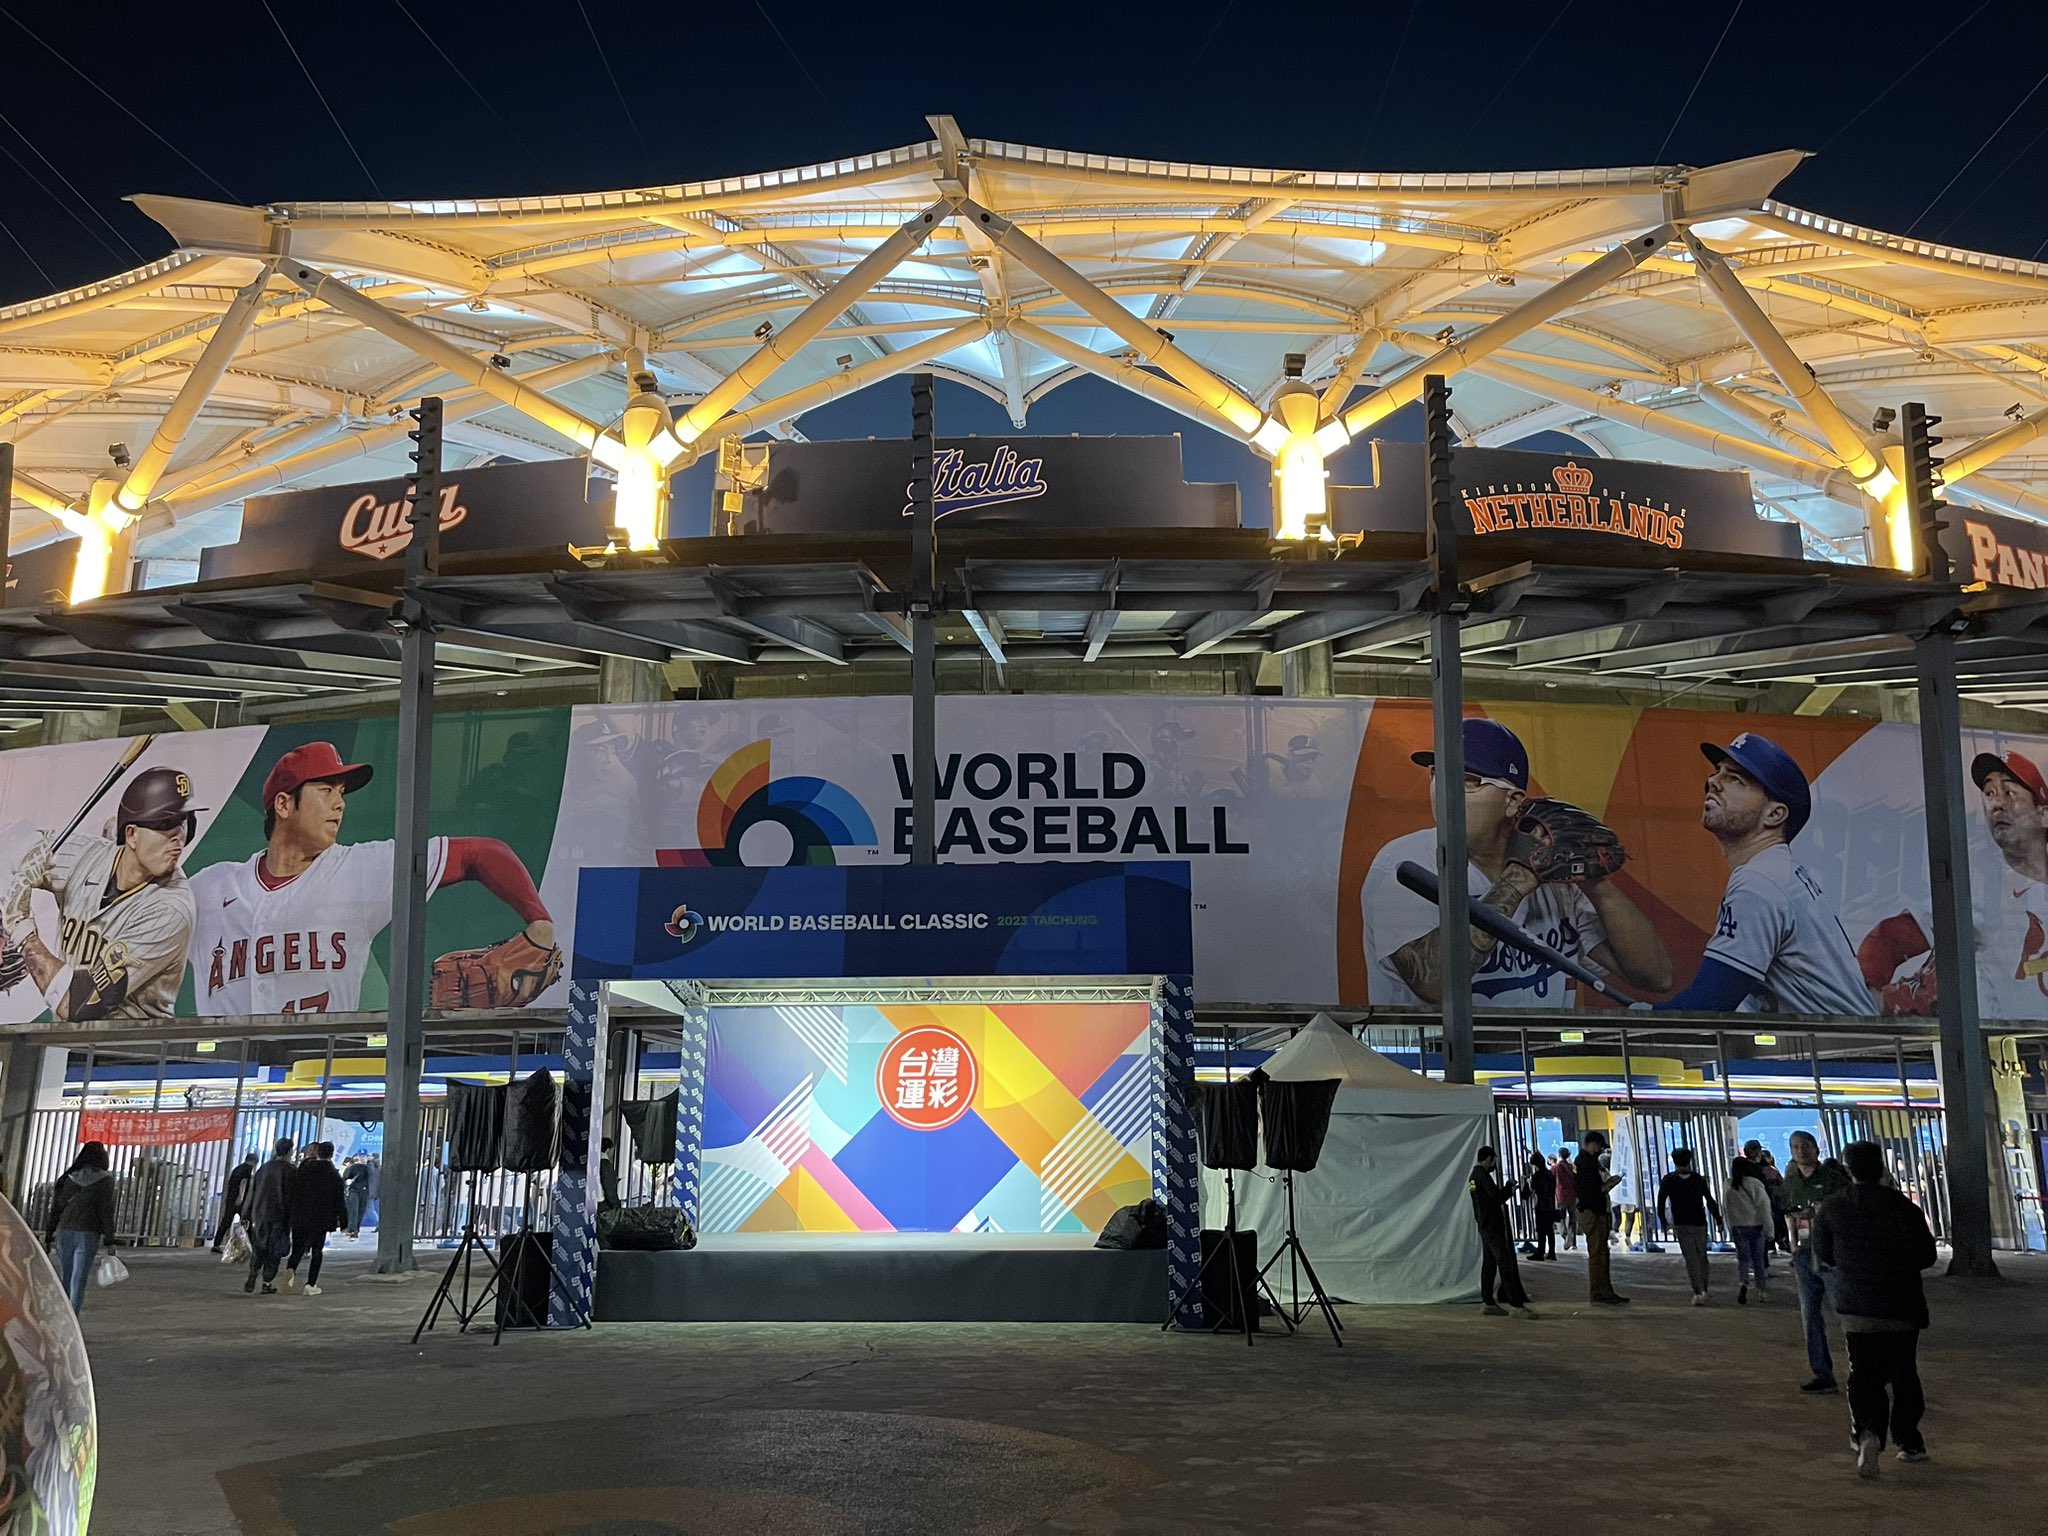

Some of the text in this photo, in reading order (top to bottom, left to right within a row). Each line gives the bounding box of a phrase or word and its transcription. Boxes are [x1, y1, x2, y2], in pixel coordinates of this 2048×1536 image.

[1461, 482, 1687, 518] KINGDOM OF THE
[1464, 492, 1685, 550] NETHERLANDS
[1963, 519, 2048, 590] PAN
[892, 752, 1147, 800] WORLD
[708, 913, 1099, 932] WORLD BASEBALL CLASSIC 2023 TAICHUNG
[207, 931, 347, 998] ANGELS
[898, 1046, 960, 1077] 台灣
[894, 1078, 959, 1110] 運彩
